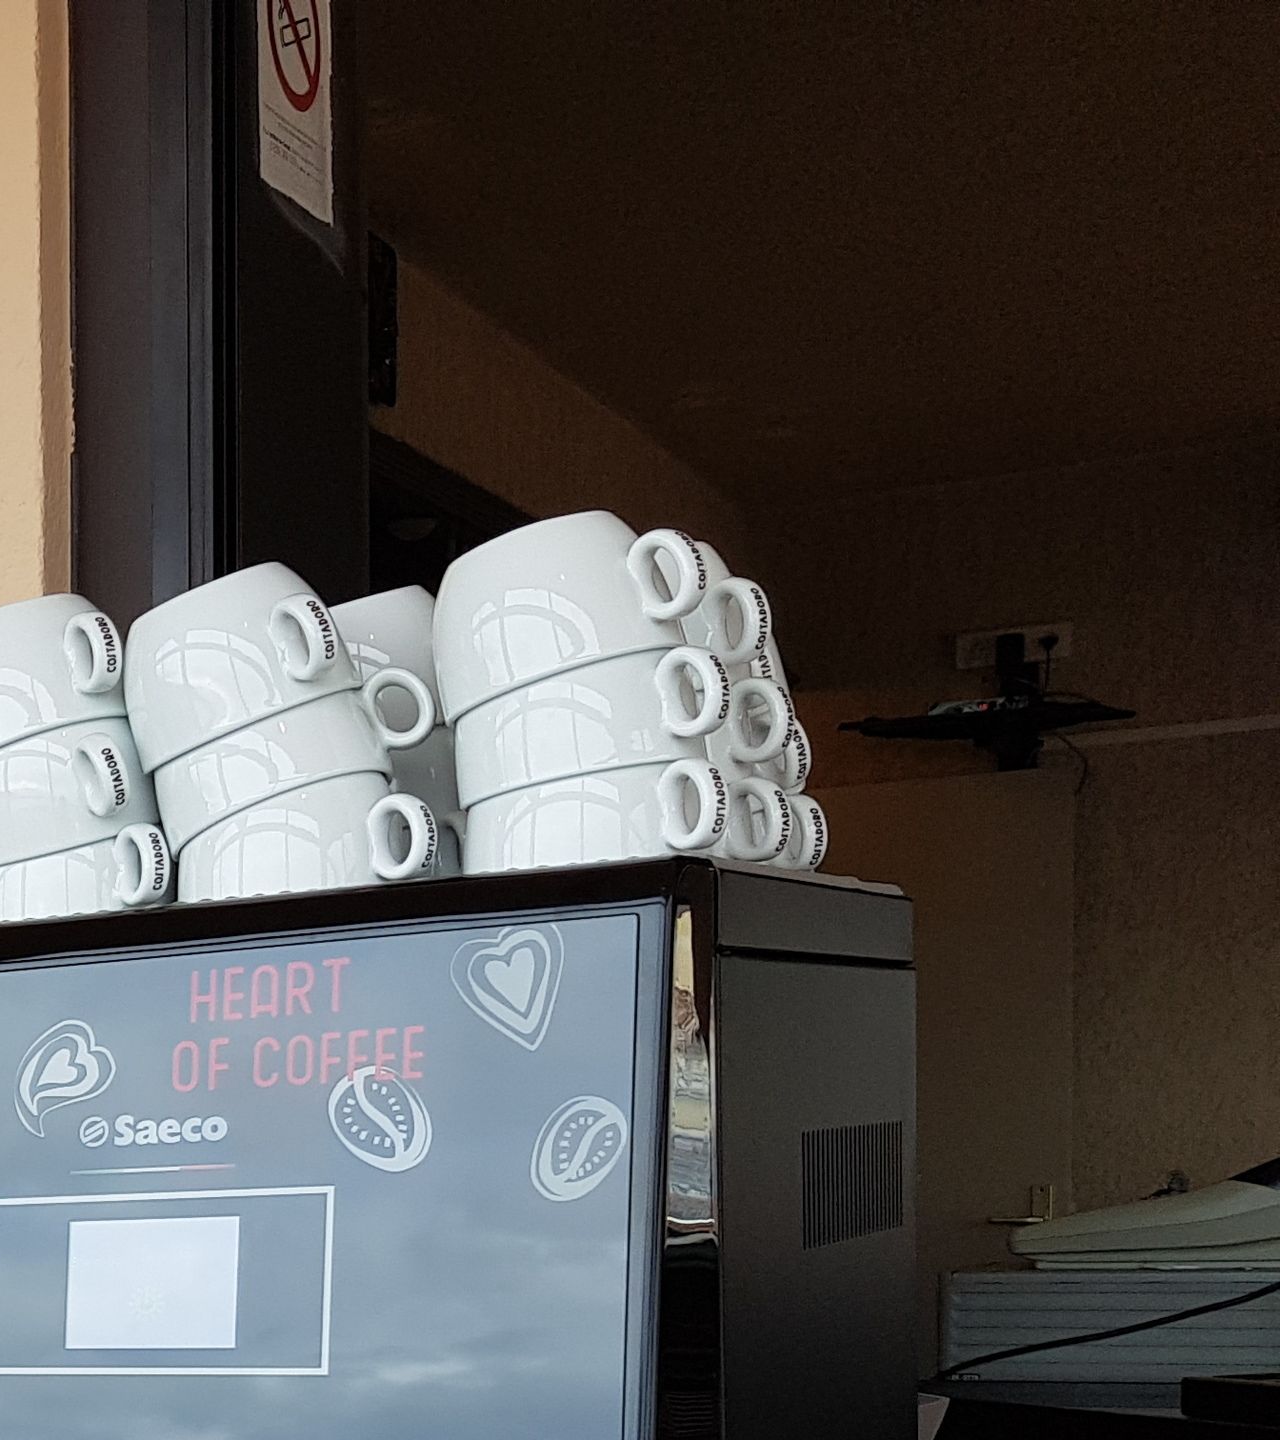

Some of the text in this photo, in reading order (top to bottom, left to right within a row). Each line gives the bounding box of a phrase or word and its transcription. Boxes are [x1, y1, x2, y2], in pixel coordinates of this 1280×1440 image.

[95, 616, 117, 673] COSTADORO
[306, 600, 335, 660] COSTADORO
[750, 587, 769, 650] COSTADORO
[709, 654, 731, 720] COSTADORO
[102, 748, 126, 806] COSTADORO
[709, 767, 728, 834] COSTADORO
[420, 805, 436, 868] COSTADORO
[775, 790, 791, 852] COSTADORO
[809, 807, 824, 866] COSTADORO
[149, 832, 165, 891] COSTADORO
[190, 957, 351, 1023] HEART
[172, 1025, 425, 1092] OF COFFEE
[113, 1114, 229, 1146] Saeco
